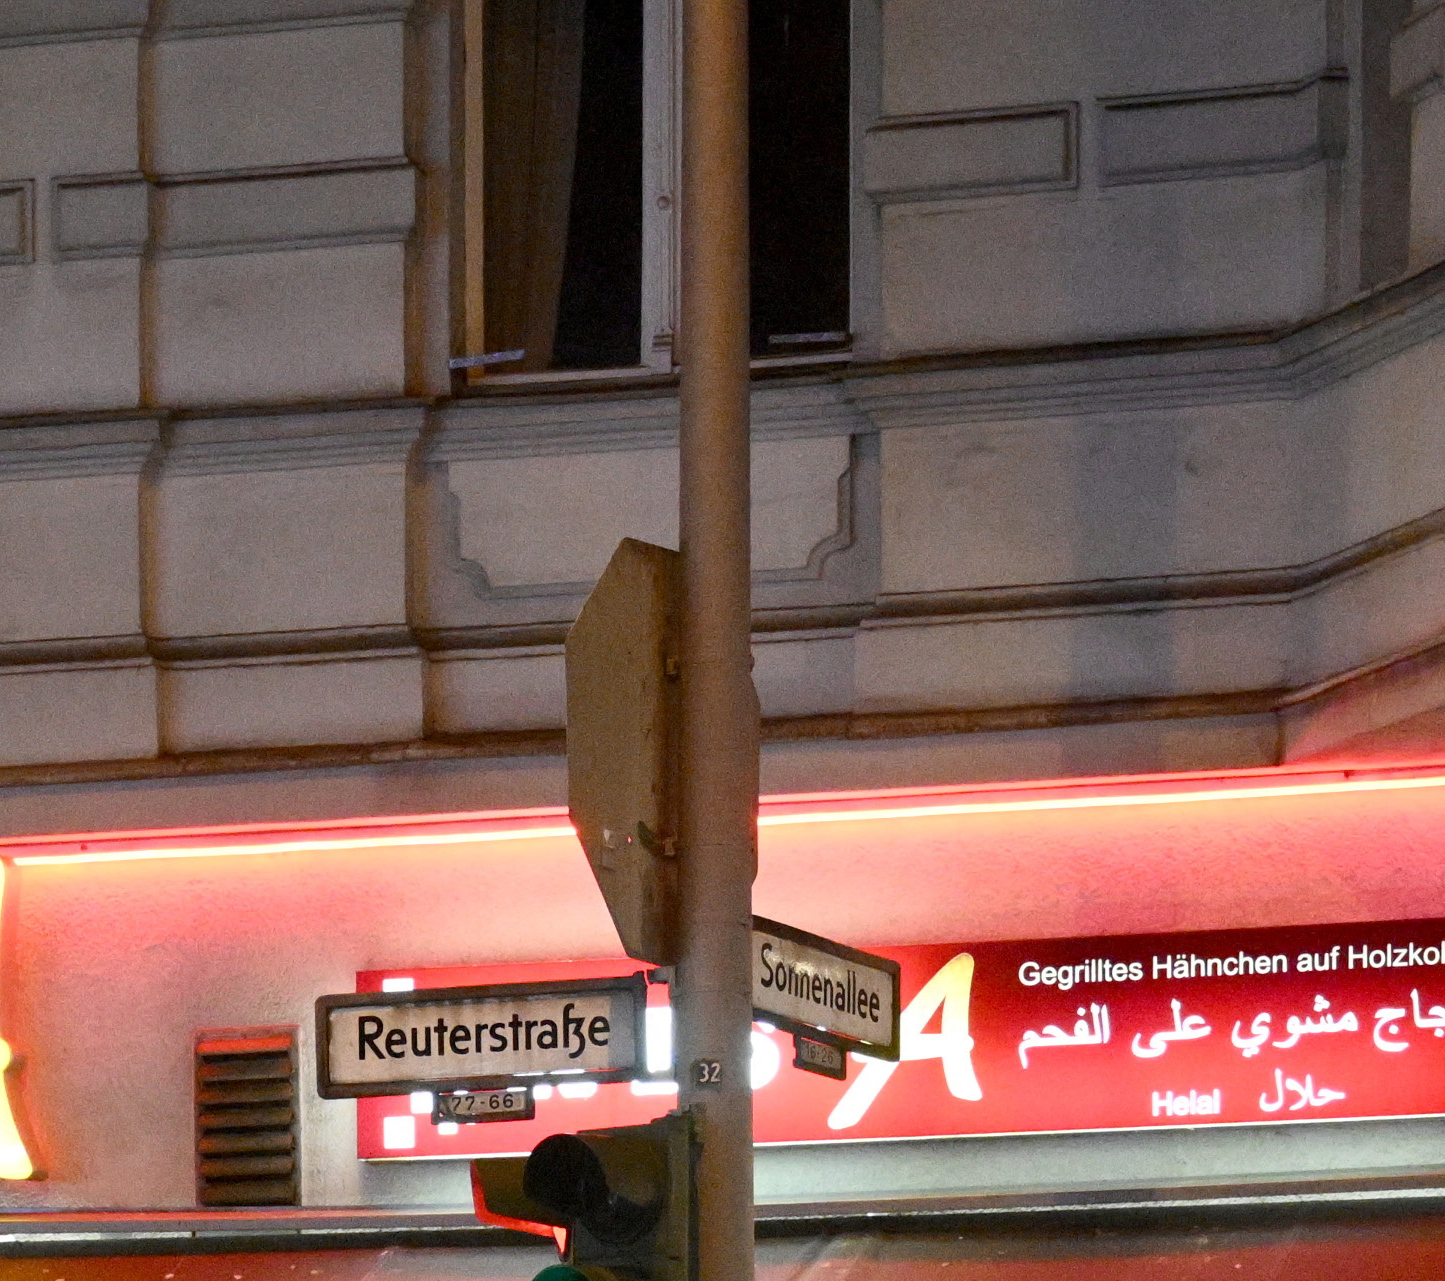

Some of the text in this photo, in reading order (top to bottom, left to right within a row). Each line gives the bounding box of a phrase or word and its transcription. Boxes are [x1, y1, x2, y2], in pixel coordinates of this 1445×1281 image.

[760, 943, 880, 1023] Sonnenallee
[1019, 958, 1144, 990] Gegrilltes
[1152, 951, 1288, 980] Hähnchen
[1296, 946, 1341, 973] auf
[358, 1003, 611, 1060] Reuterstraße
[1018, 1002, 1110, 1070] الفحم
[1131, 998, 1211, 1059] على
[1231, 994, 1359, 1058] مشوي
[699, 1062, 721, 1083] 32
[1259, 1067, 1346, 1112] حلال
[451, 1092, 514, 1112] 77-66
[1152, 1088, 1221, 1117] Helal
